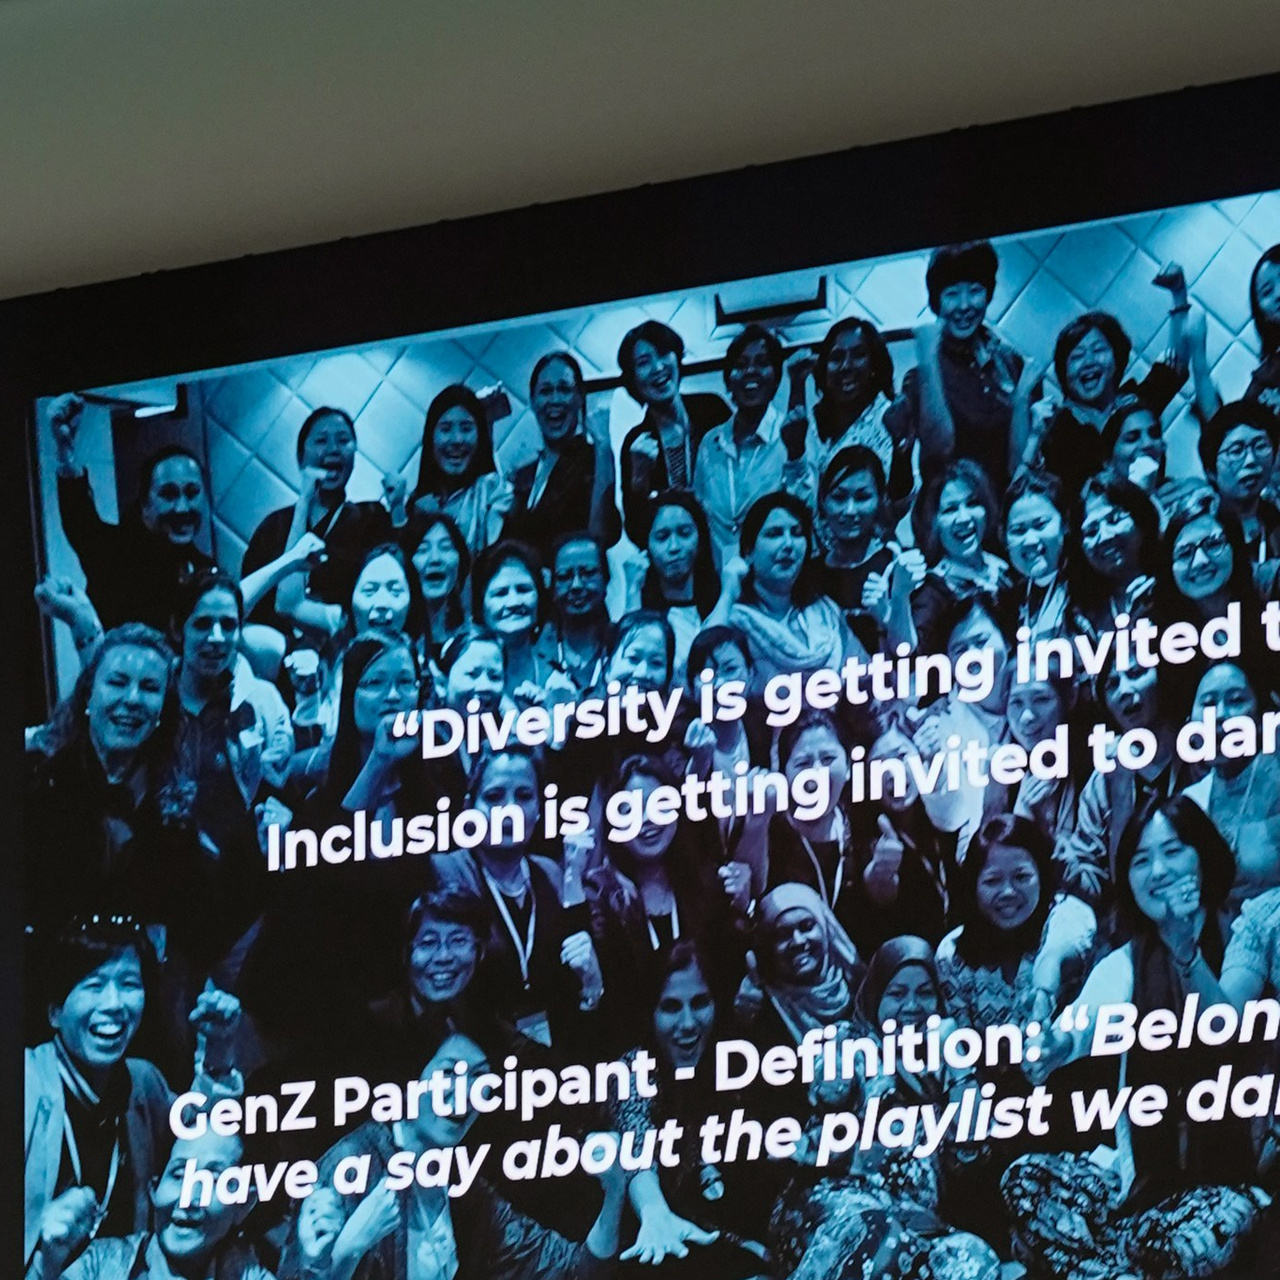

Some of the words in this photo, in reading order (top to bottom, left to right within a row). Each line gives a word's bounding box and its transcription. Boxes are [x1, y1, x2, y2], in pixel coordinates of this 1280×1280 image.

[392, 681, 683, 759] “Diversity
[700, 669, 747, 725] is
[764, 643, 995, 727] getting
[1016, 602, 1241, 684] invited
[268, 797, 525, 872] Inclusion
[544, 784, 590, 842] is
[606, 761, 830, 843] getting
[851, 724, 1069, 803] invited
[1088, 723, 1157, 774] to
[169, 1081, 317, 1141] GenZ
[334, 1051, 658, 1127] Participant
[675, 1066, 695, 1080] -
[715, 1015, 1041, 1091] Definition:
[179, 1158, 318, 1208] have
[333, 1154, 371, 1195] a
[383, 1143, 491, 1198] say
[502, 1120, 684, 1181] about
[699, 1109, 802, 1164] the
[811, 1083, 1053, 1167] playlist
[1071, 1084, 1168, 1132] we
[1186, 1064, 1280, 1122] da
